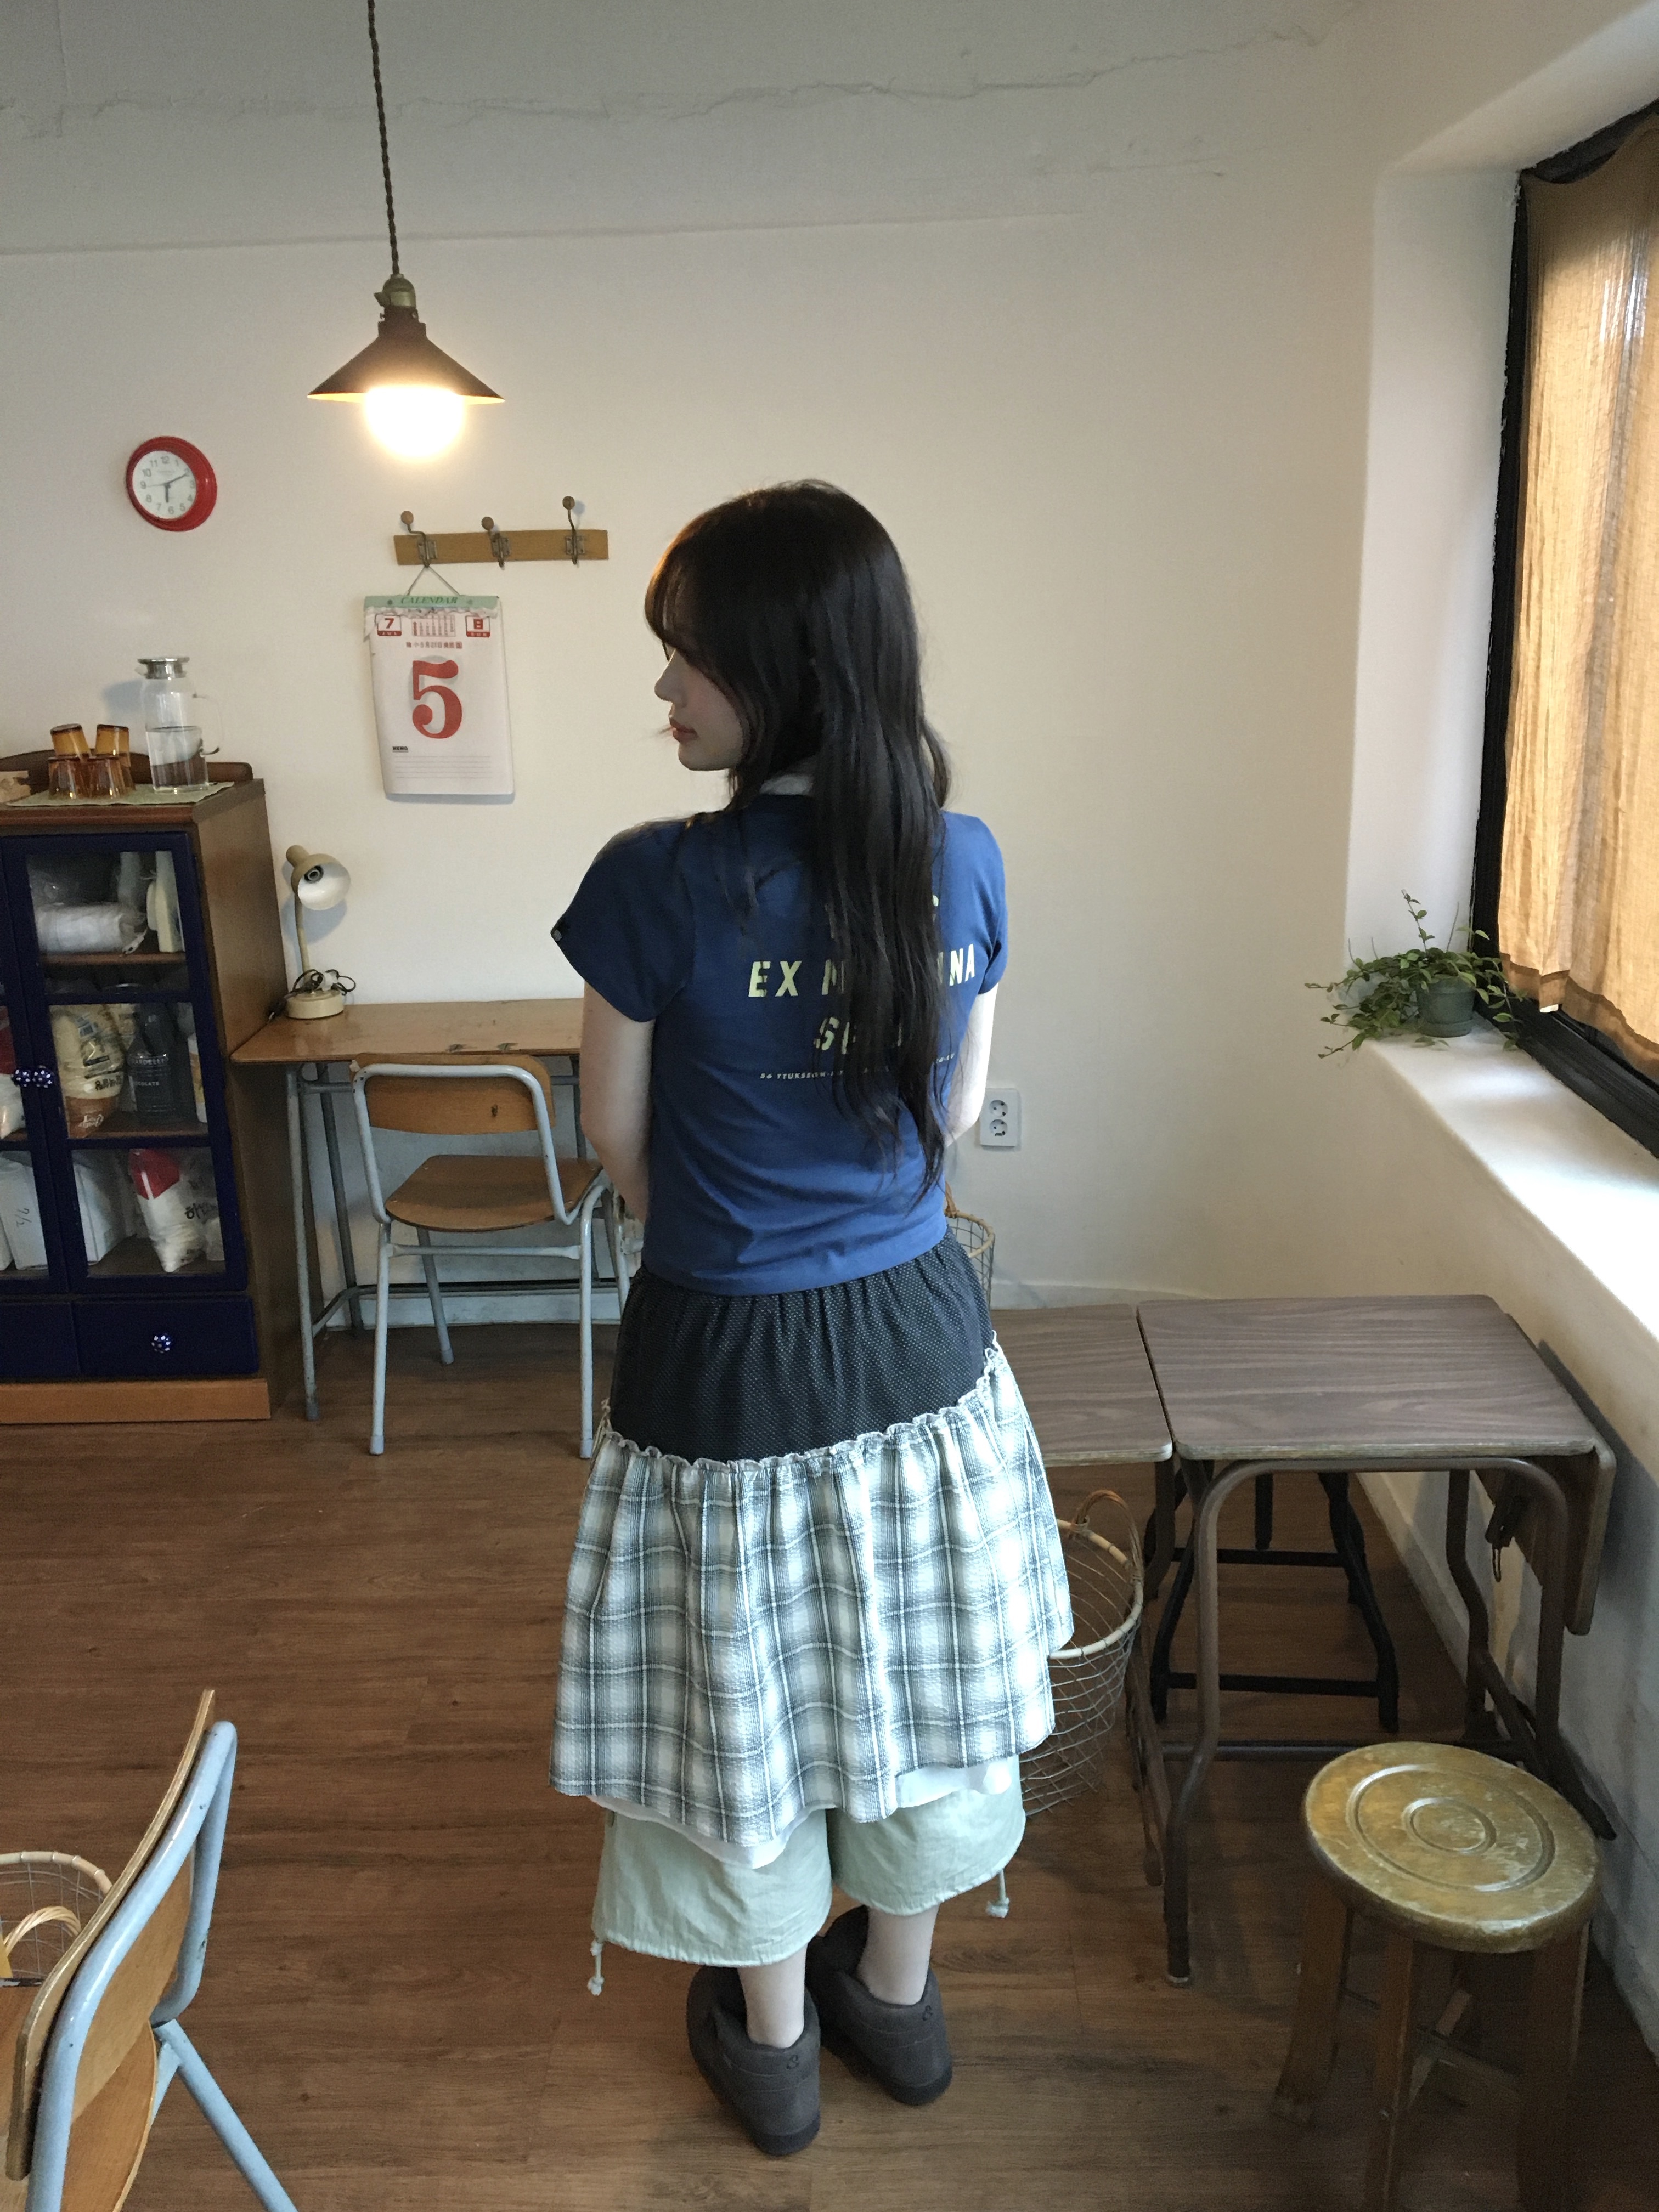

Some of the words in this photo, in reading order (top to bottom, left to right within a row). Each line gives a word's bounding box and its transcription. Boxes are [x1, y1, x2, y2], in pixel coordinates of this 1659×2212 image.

[160, 456, 170, 464] 12
[142, 468, 151, 477] 10
[140, 481, 146, 489] 9
[189, 480, 195, 489] 3
[146, 494, 152, 503] 8
[157, 503, 162, 511] 7
[168, 506, 174, 514] 6
[179, 502, 185, 511] 5
[385, 618, 394, 629] 7
[413, 660, 462, 739] 5
[748, 960, 802, 998] EX
